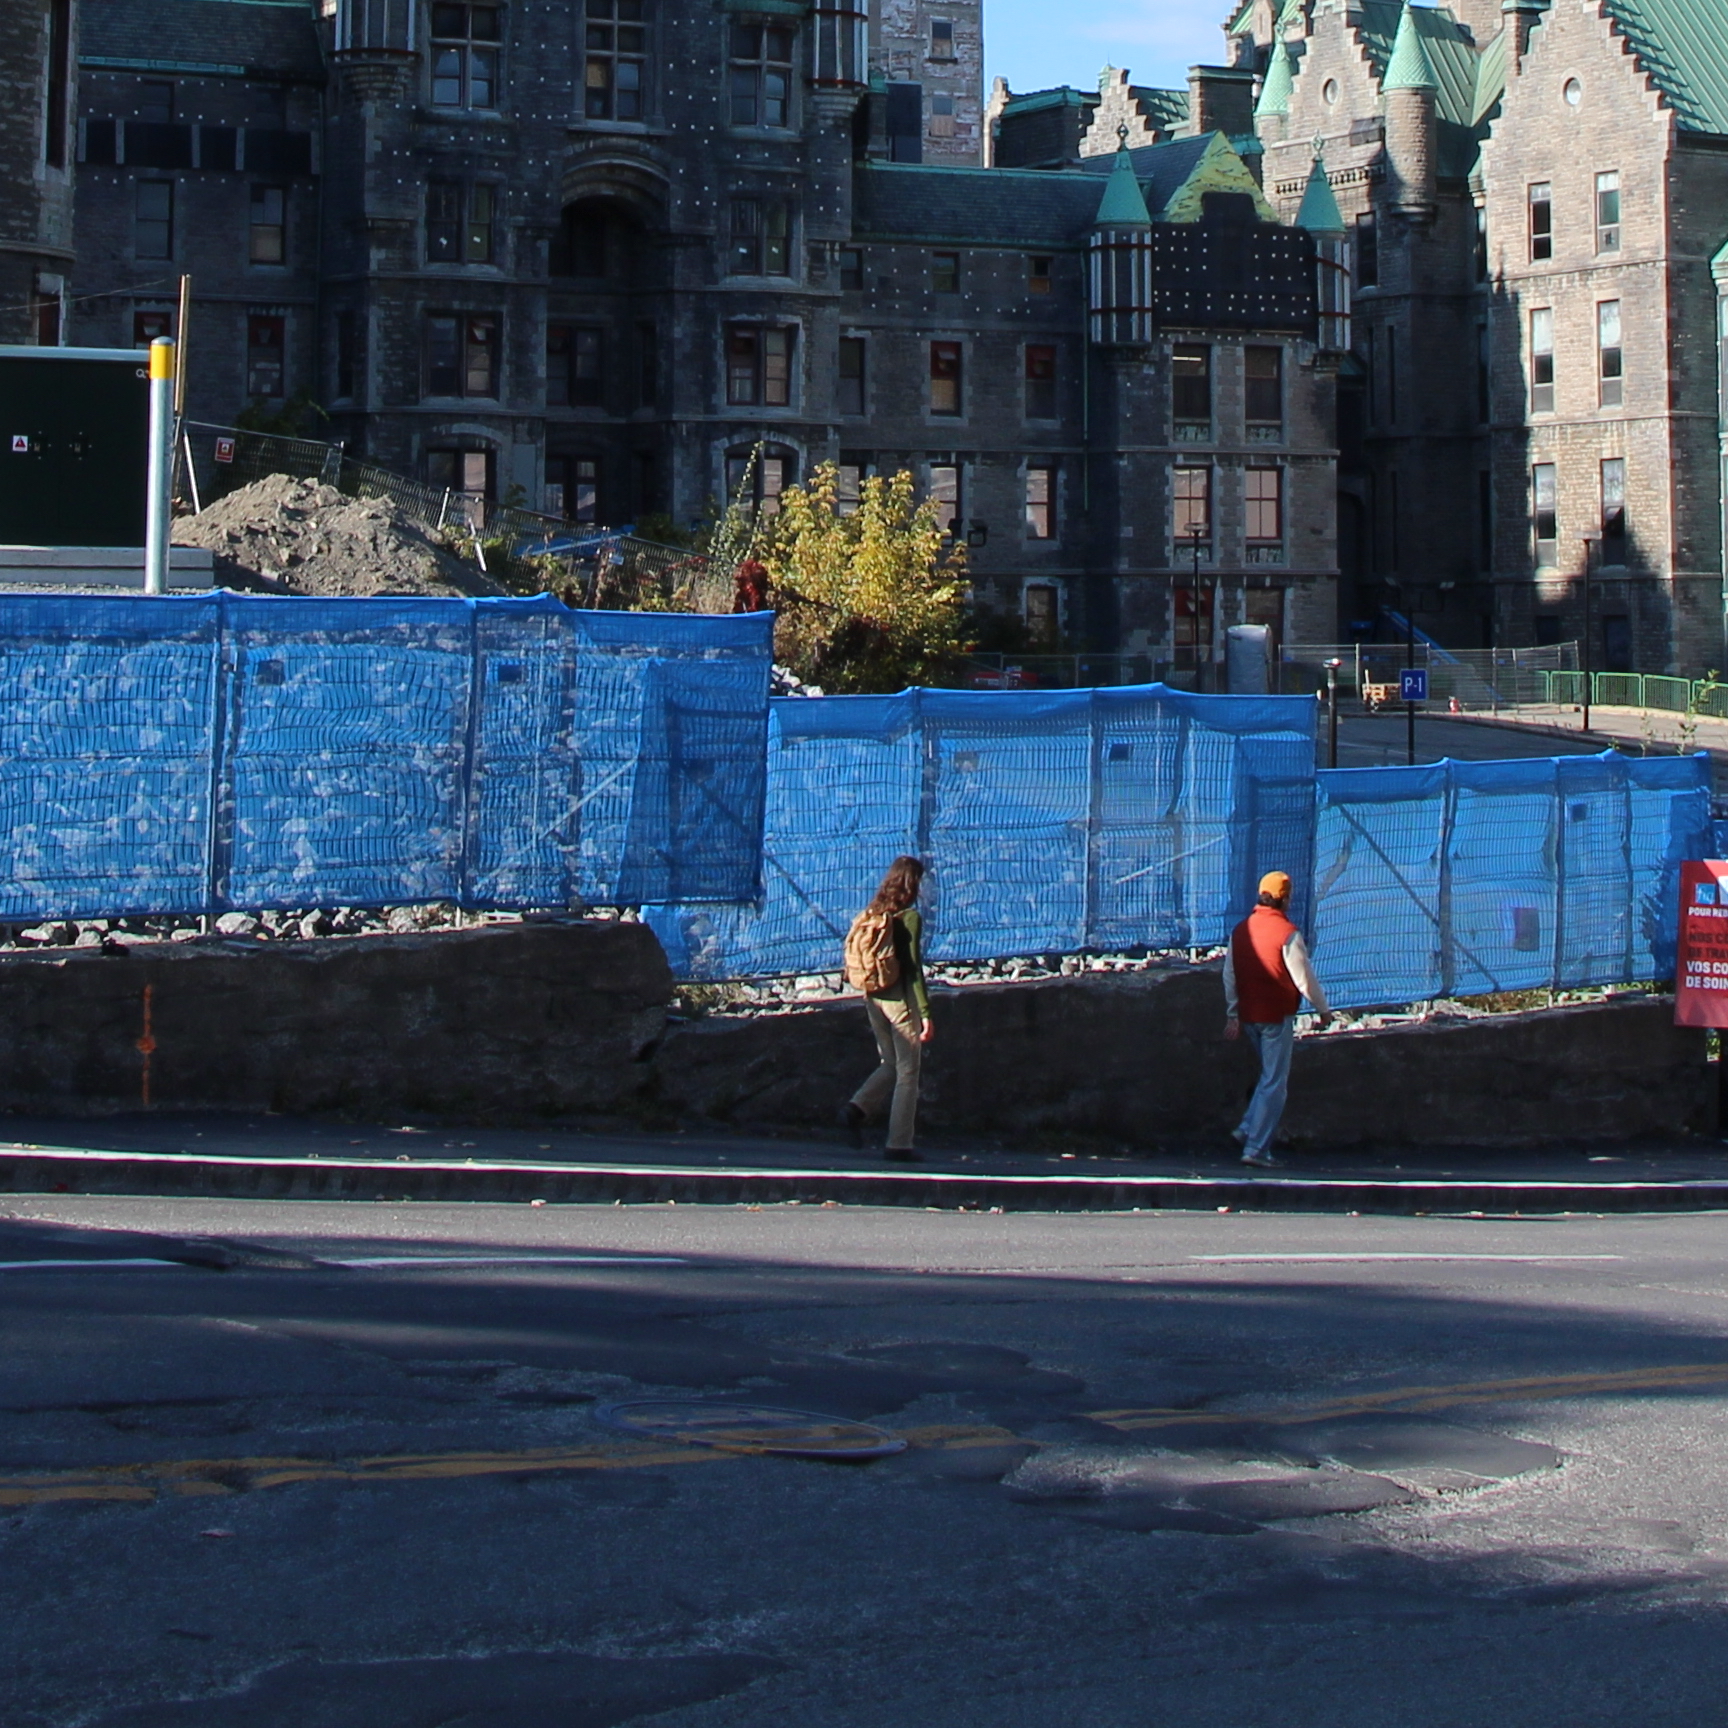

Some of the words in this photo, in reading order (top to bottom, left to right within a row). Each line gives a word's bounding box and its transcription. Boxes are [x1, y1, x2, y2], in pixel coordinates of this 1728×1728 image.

[1405, 677, 1422, 693] P-1
[1688, 906, 1711, 916] POUR
[1686, 960, 1711, 973] VOS
[1686, 976, 1700, 988] DE
